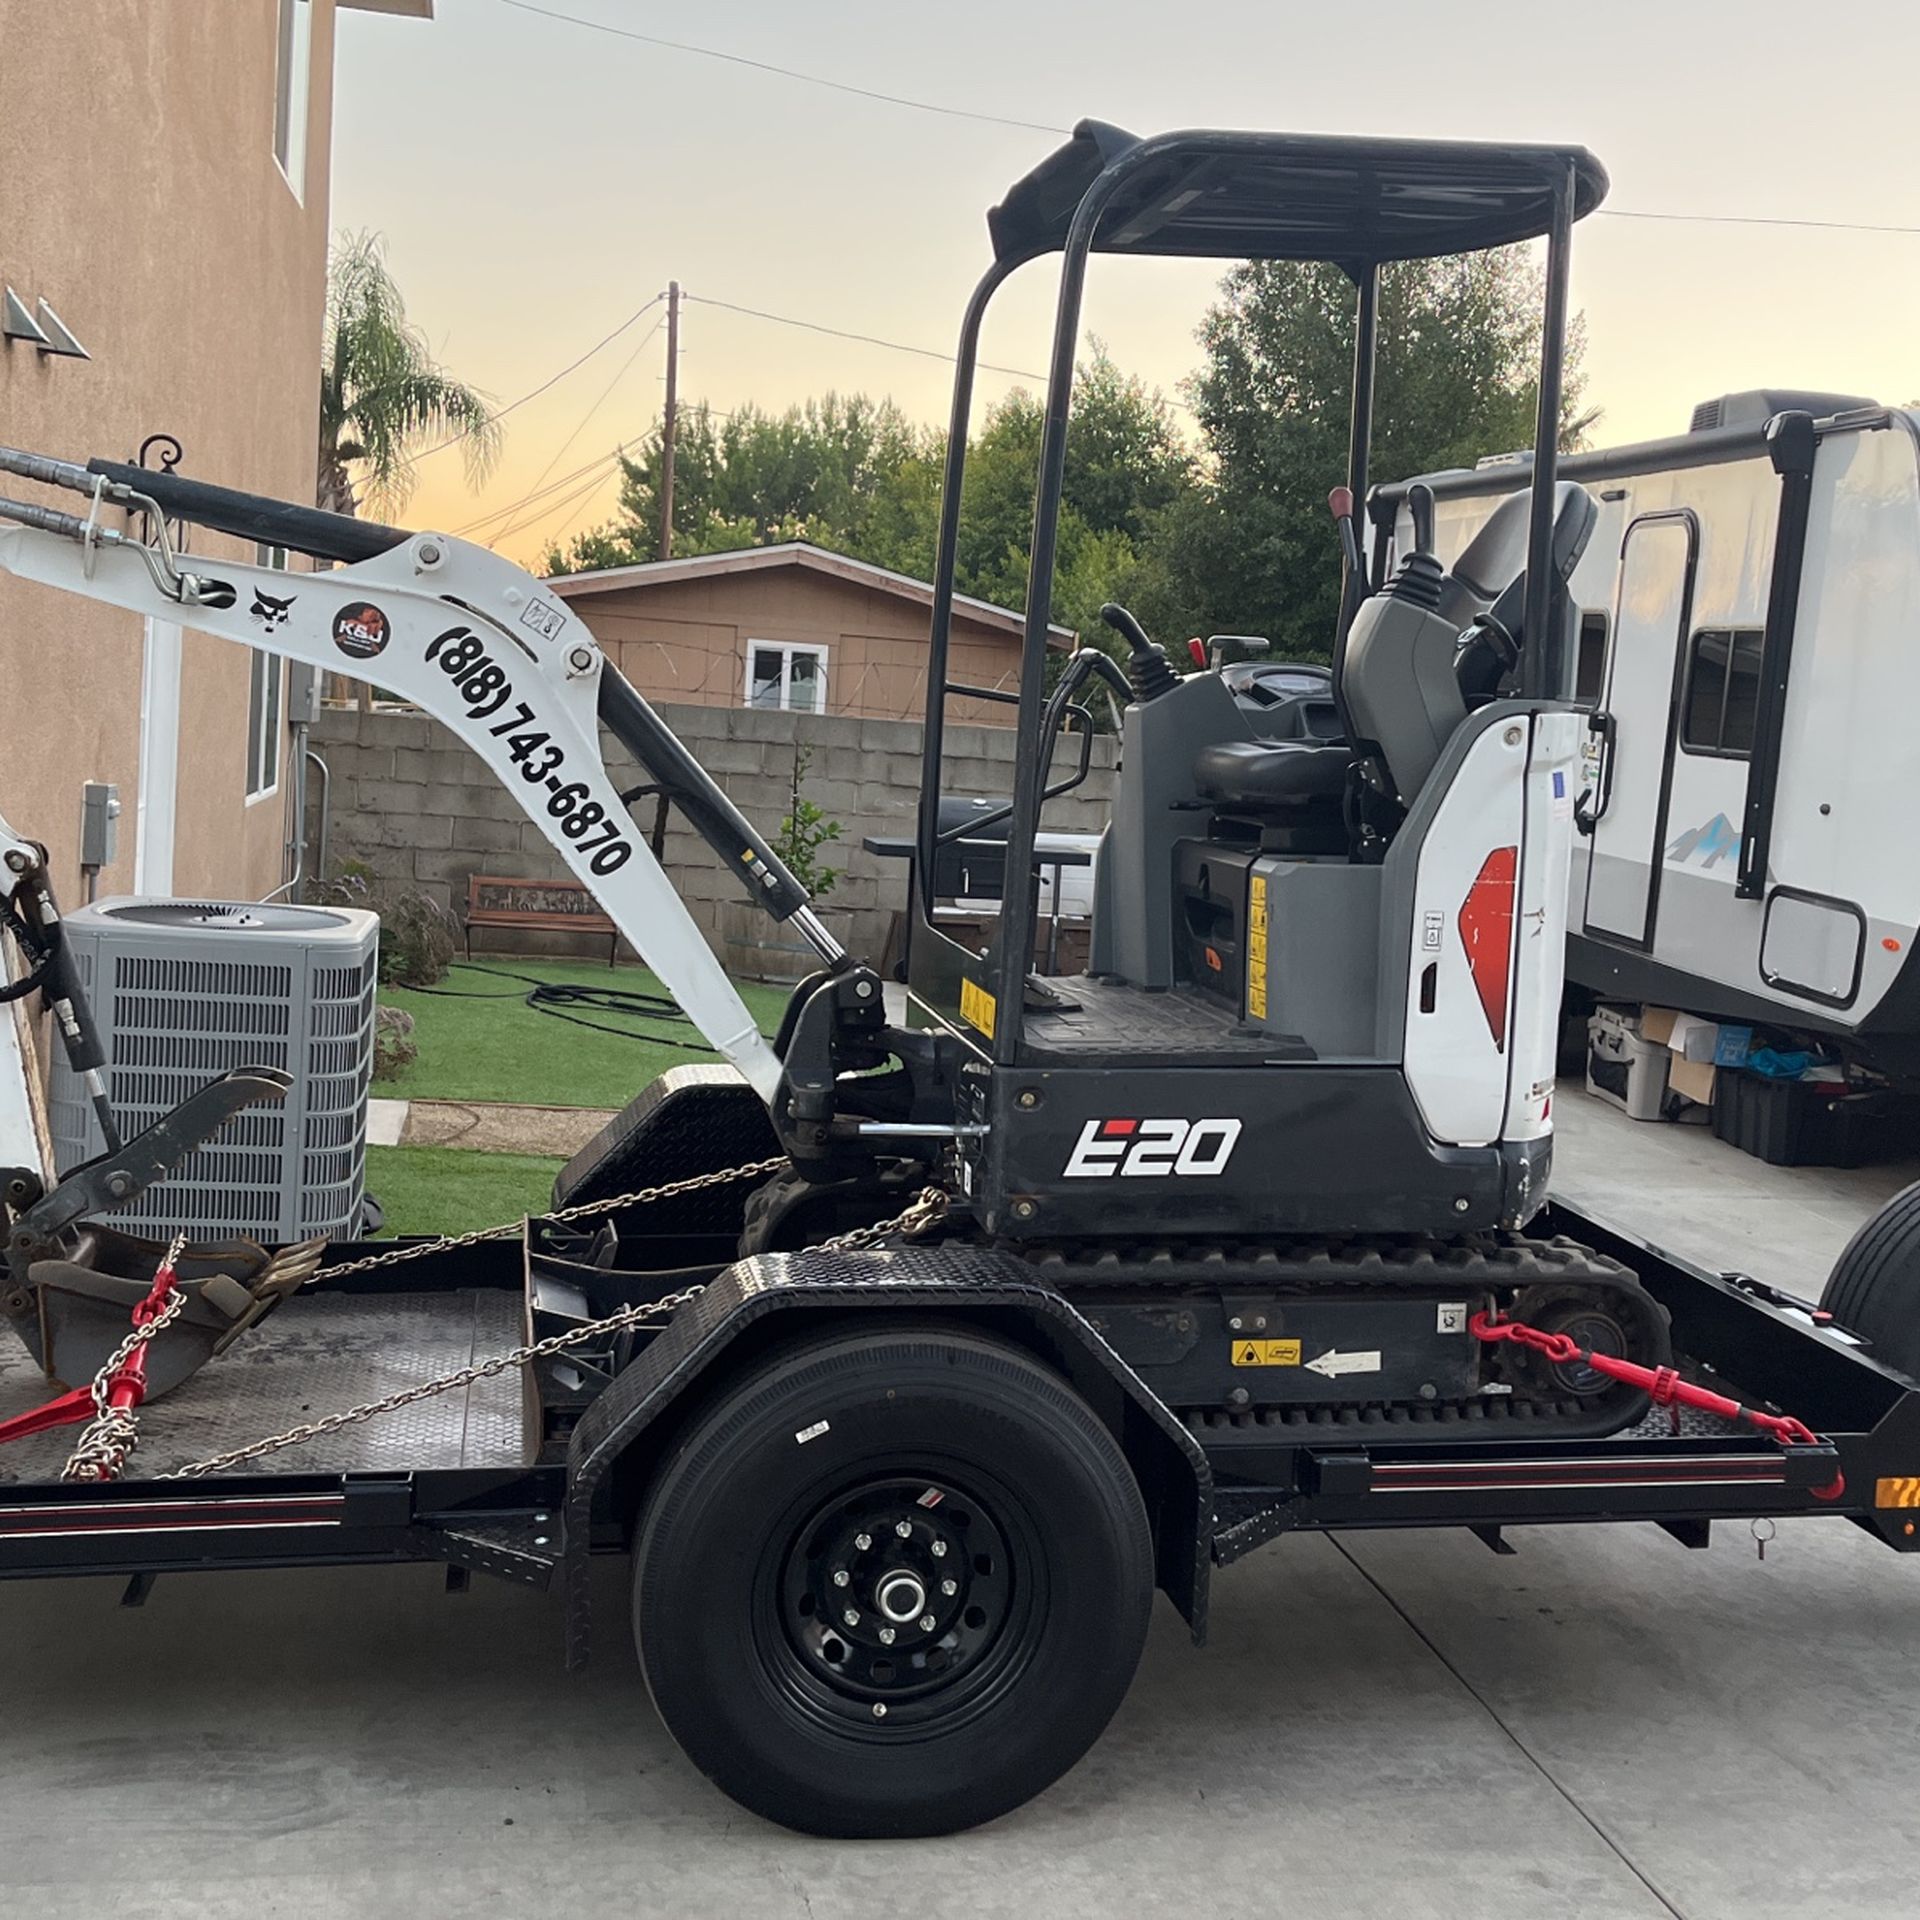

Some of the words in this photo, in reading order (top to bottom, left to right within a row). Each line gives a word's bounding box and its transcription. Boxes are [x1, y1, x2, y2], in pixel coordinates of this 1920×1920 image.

[425, 626, 512, 719] (818)
[490, 702, 632, 876] 743-6870
[1063, 1118, 1243, 1177] E20
